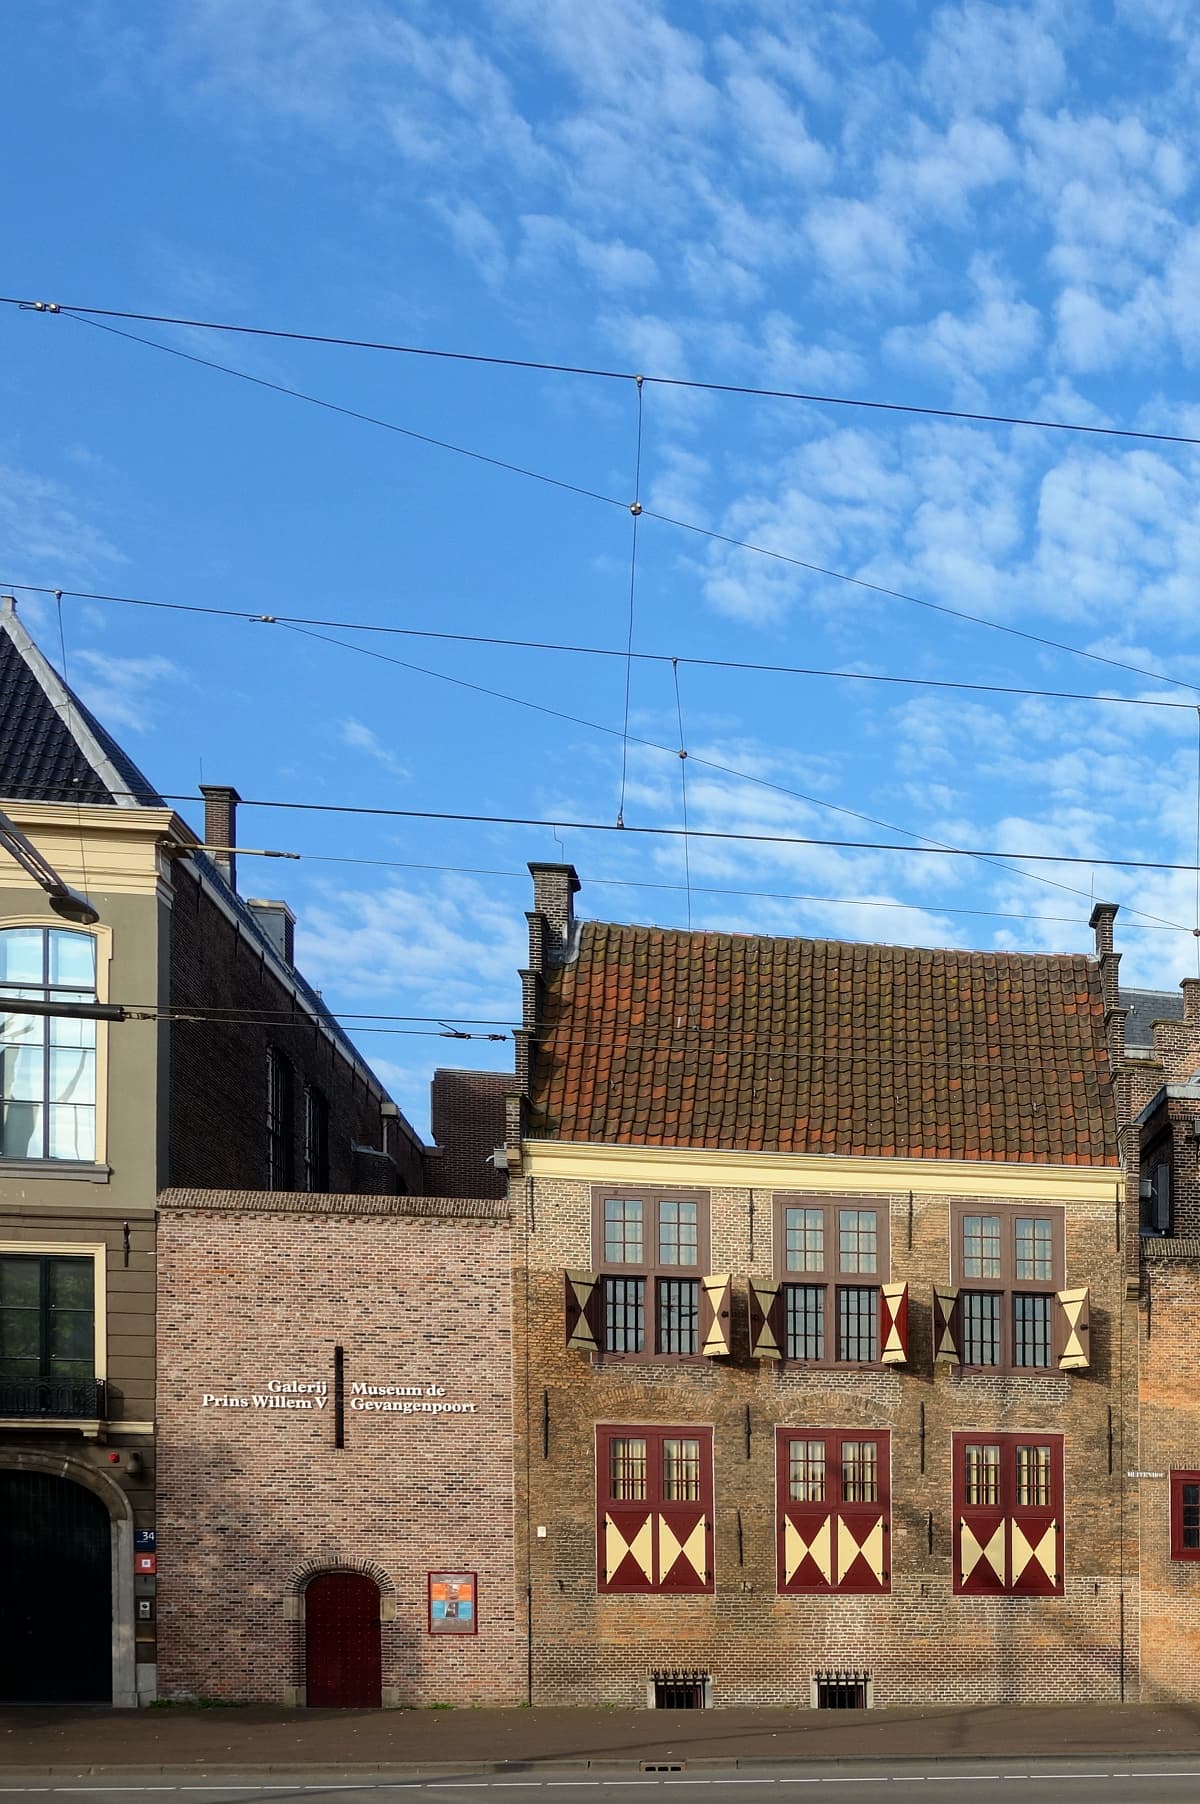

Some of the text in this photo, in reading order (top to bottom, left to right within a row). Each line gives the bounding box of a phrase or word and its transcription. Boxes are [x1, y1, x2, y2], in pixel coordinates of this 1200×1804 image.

[267, 1379, 328, 1395] Galerij
[350, 1382, 446, 1397] Museum de
[202, 1394, 328, 1409] Prins Willem V
[350, 1398, 478, 1414] Gevangenpoort
[142, 1531, 154, 1541] 34
